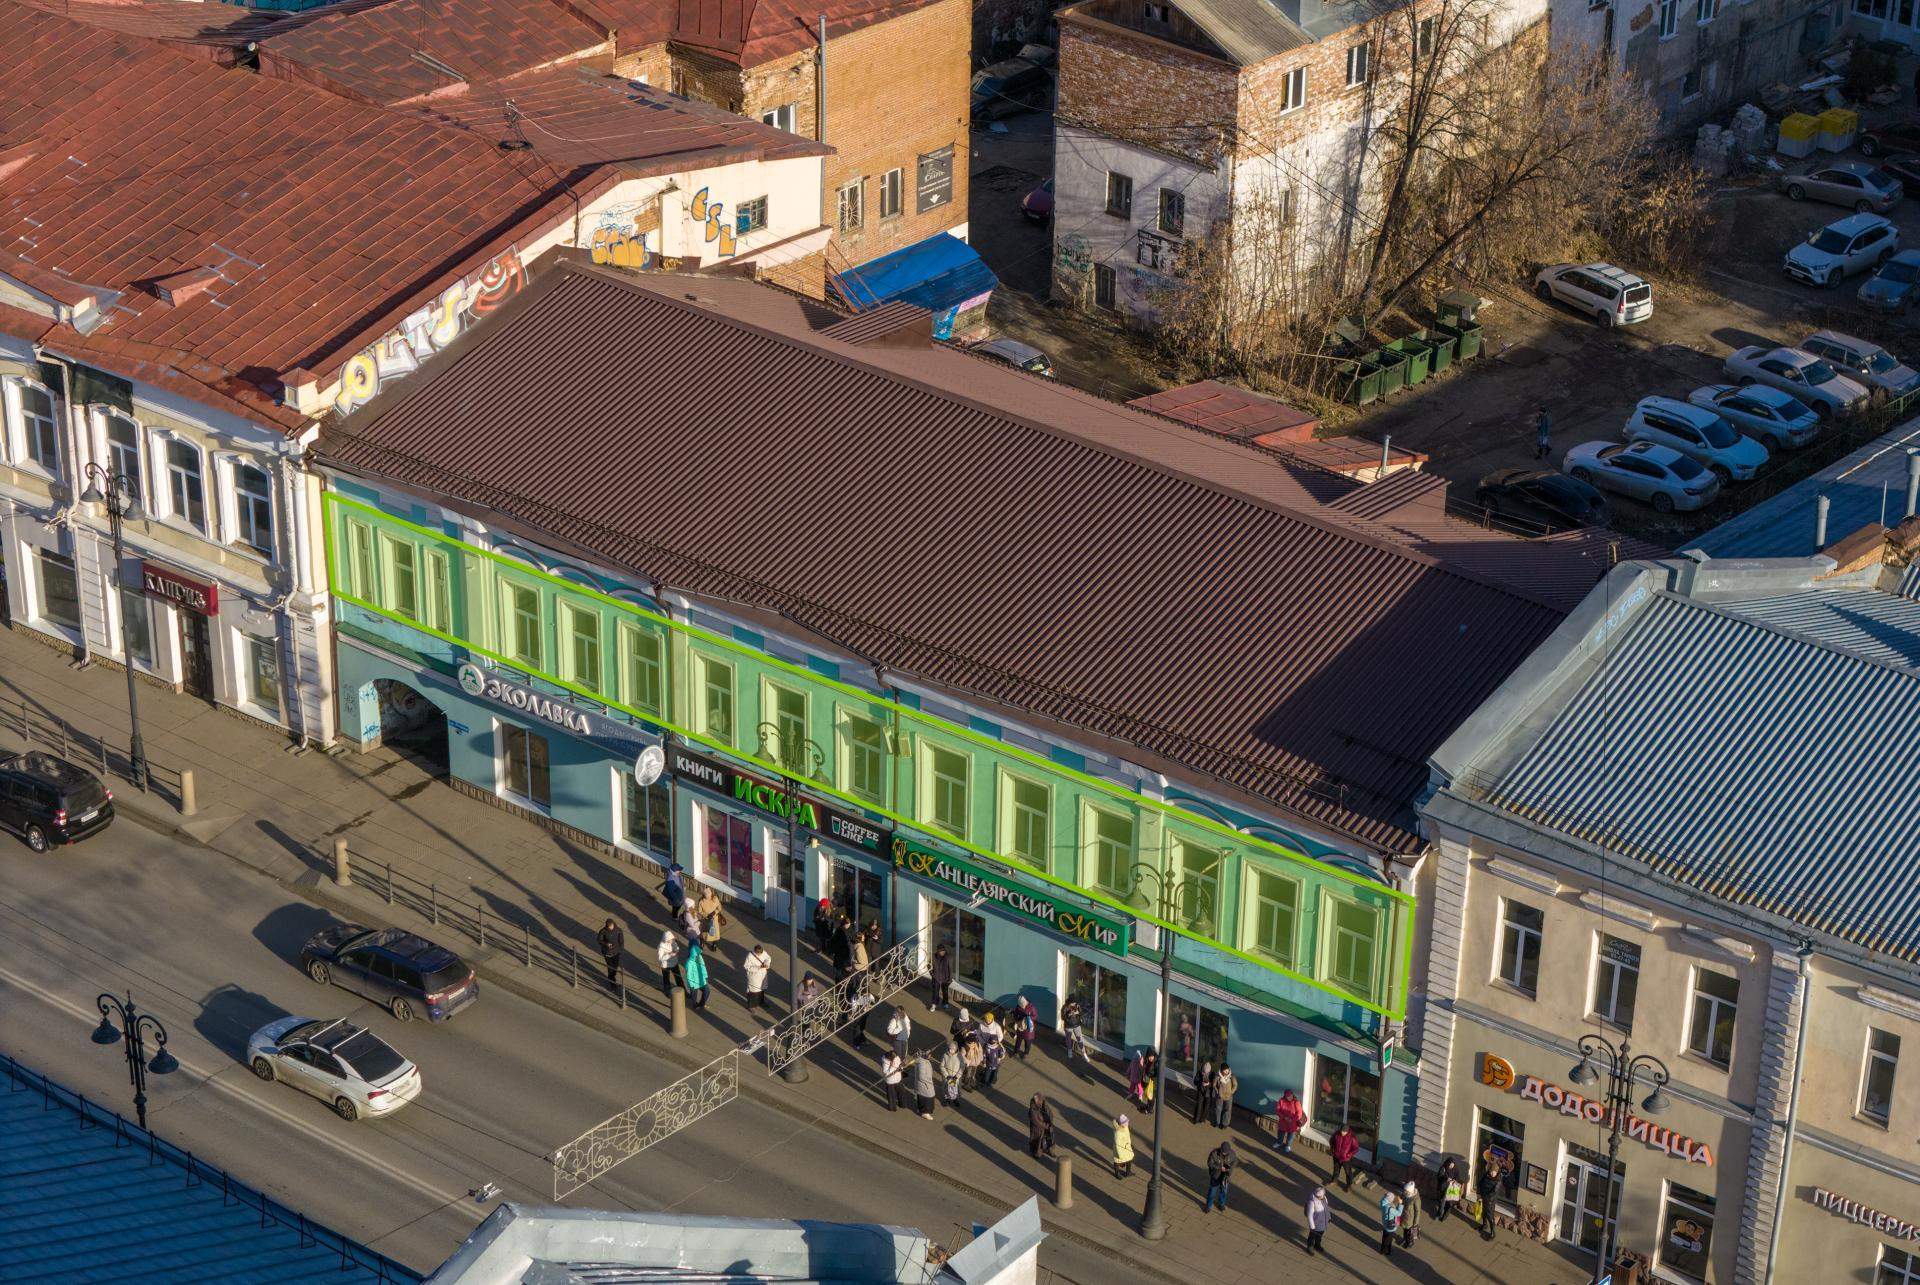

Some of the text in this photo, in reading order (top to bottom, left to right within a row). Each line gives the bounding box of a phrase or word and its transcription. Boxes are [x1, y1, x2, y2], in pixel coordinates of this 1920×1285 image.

[486, 678, 591, 736] ЭКОЛАВКА
[676, 755, 723, 786] КНИГИ
[841, 819, 880, 842] COFFEE
[841, 828, 864, 844] LIKE
[908, 850, 1119, 946] КАНЦЕЛЯРСКИЙ МИР
[1520, 1075, 1605, 1123] ДОДО
